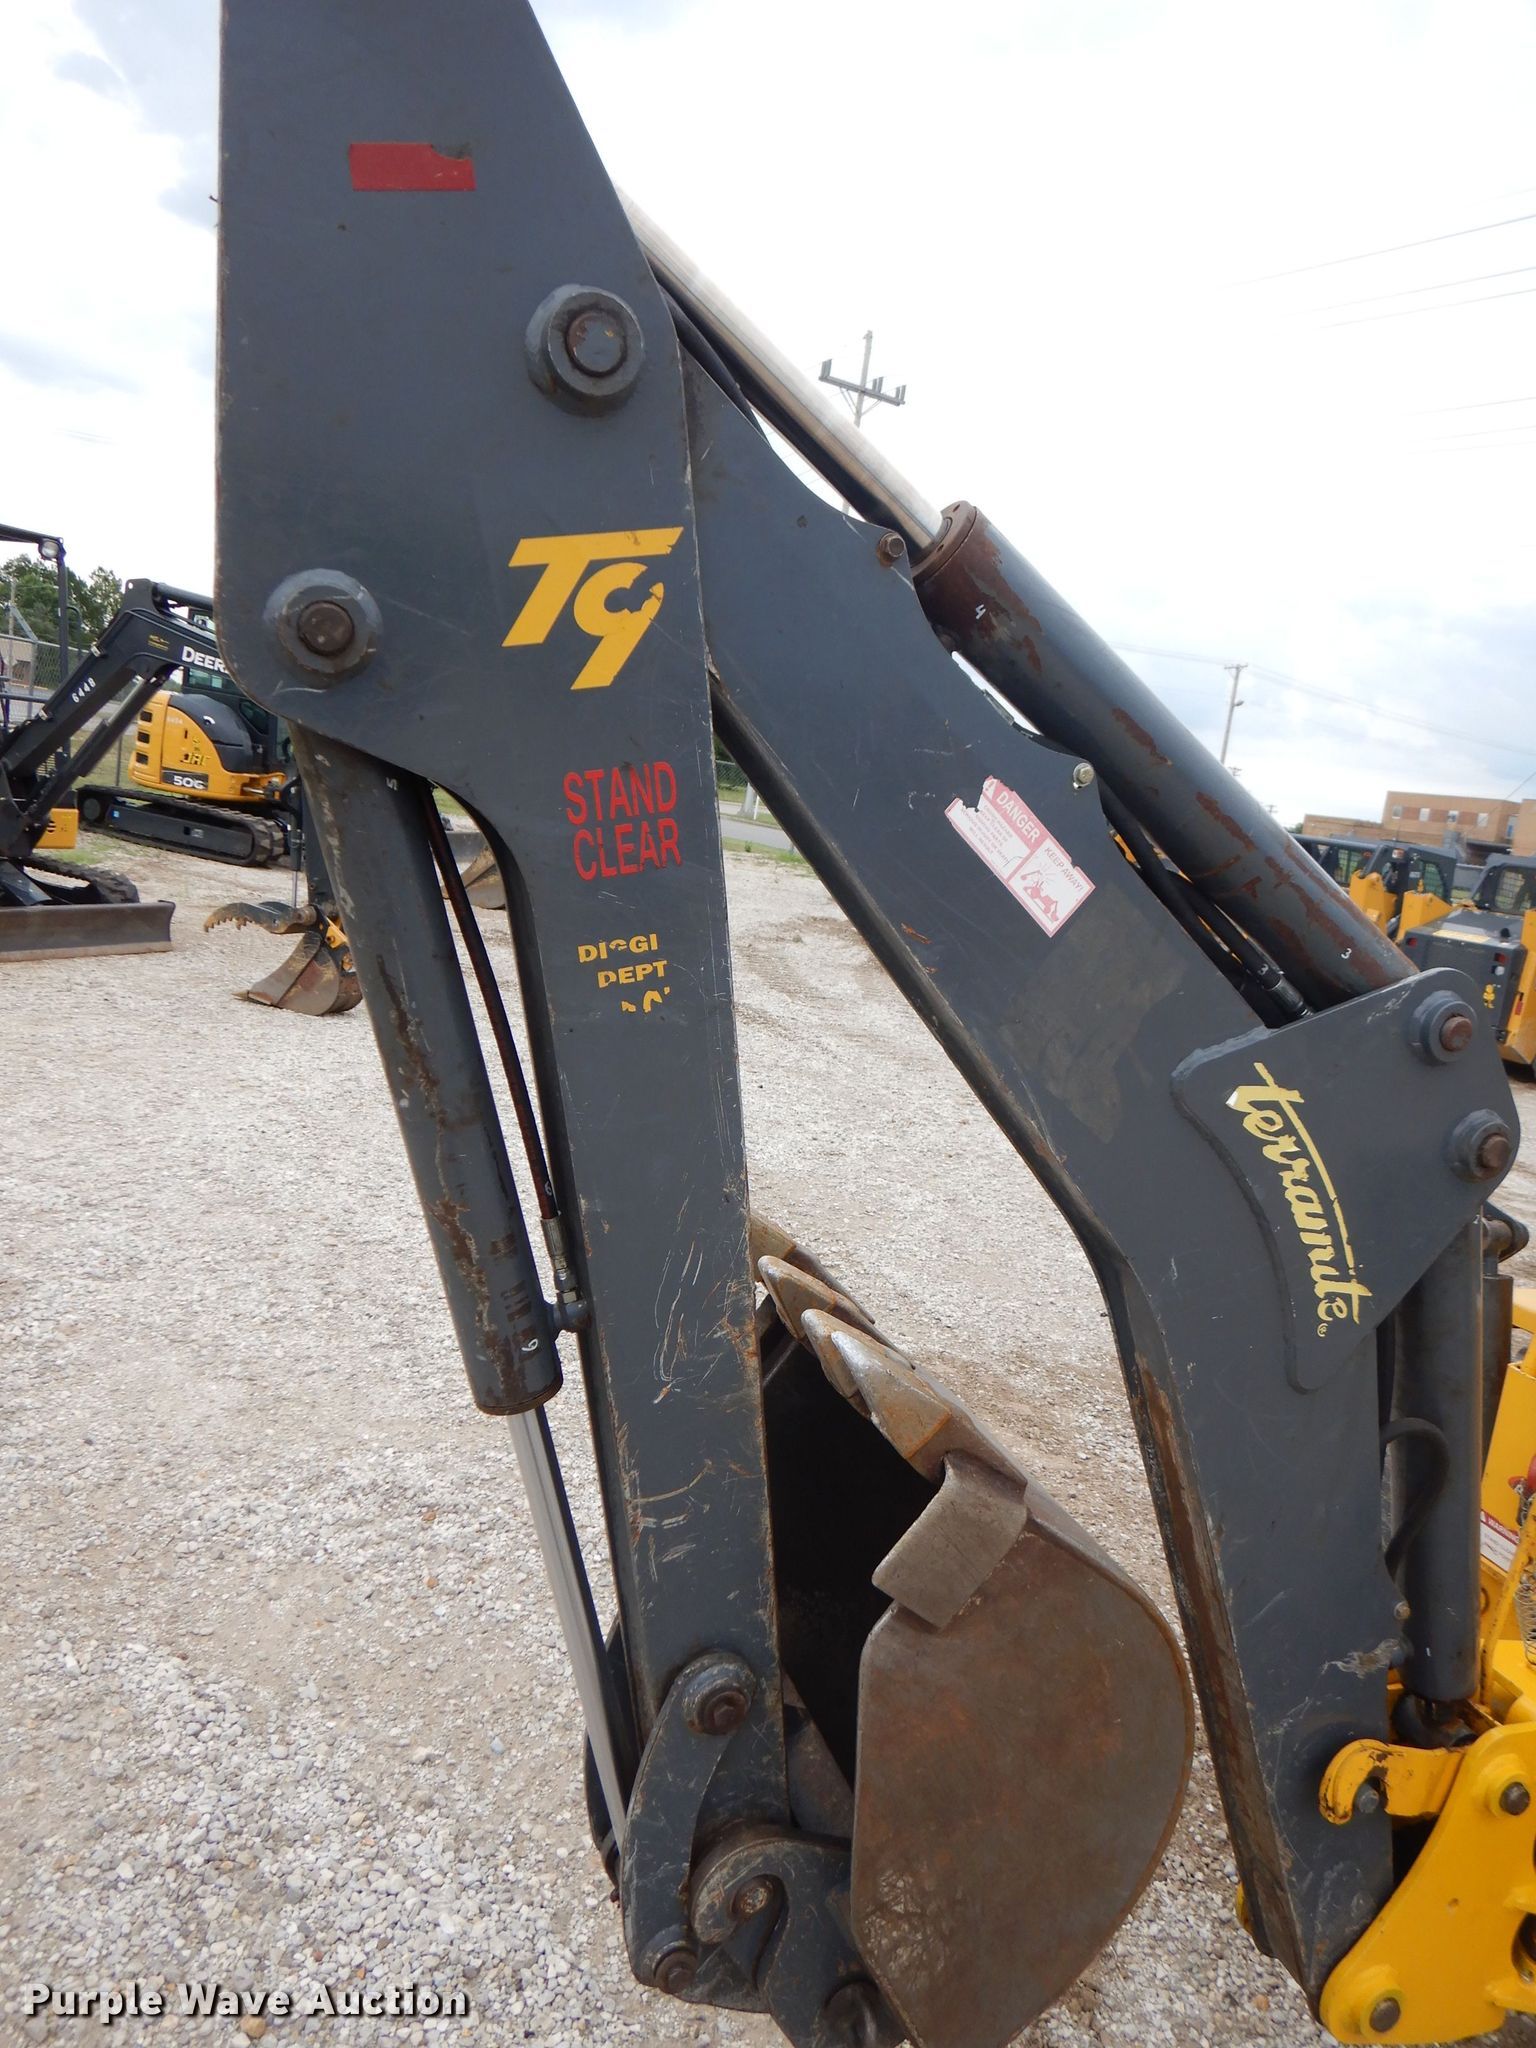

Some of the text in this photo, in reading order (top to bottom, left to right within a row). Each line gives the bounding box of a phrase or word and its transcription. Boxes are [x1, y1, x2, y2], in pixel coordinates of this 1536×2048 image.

[181, 645, 230, 675] DEER
[563, 761, 677, 826] STAND
[995, 789, 1041, 844] DANGER
[573, 817, 682, 881] CLEAR
[1044, 847, 1064, 871] KEEP
[597, 960, 668, 989] DEPT
